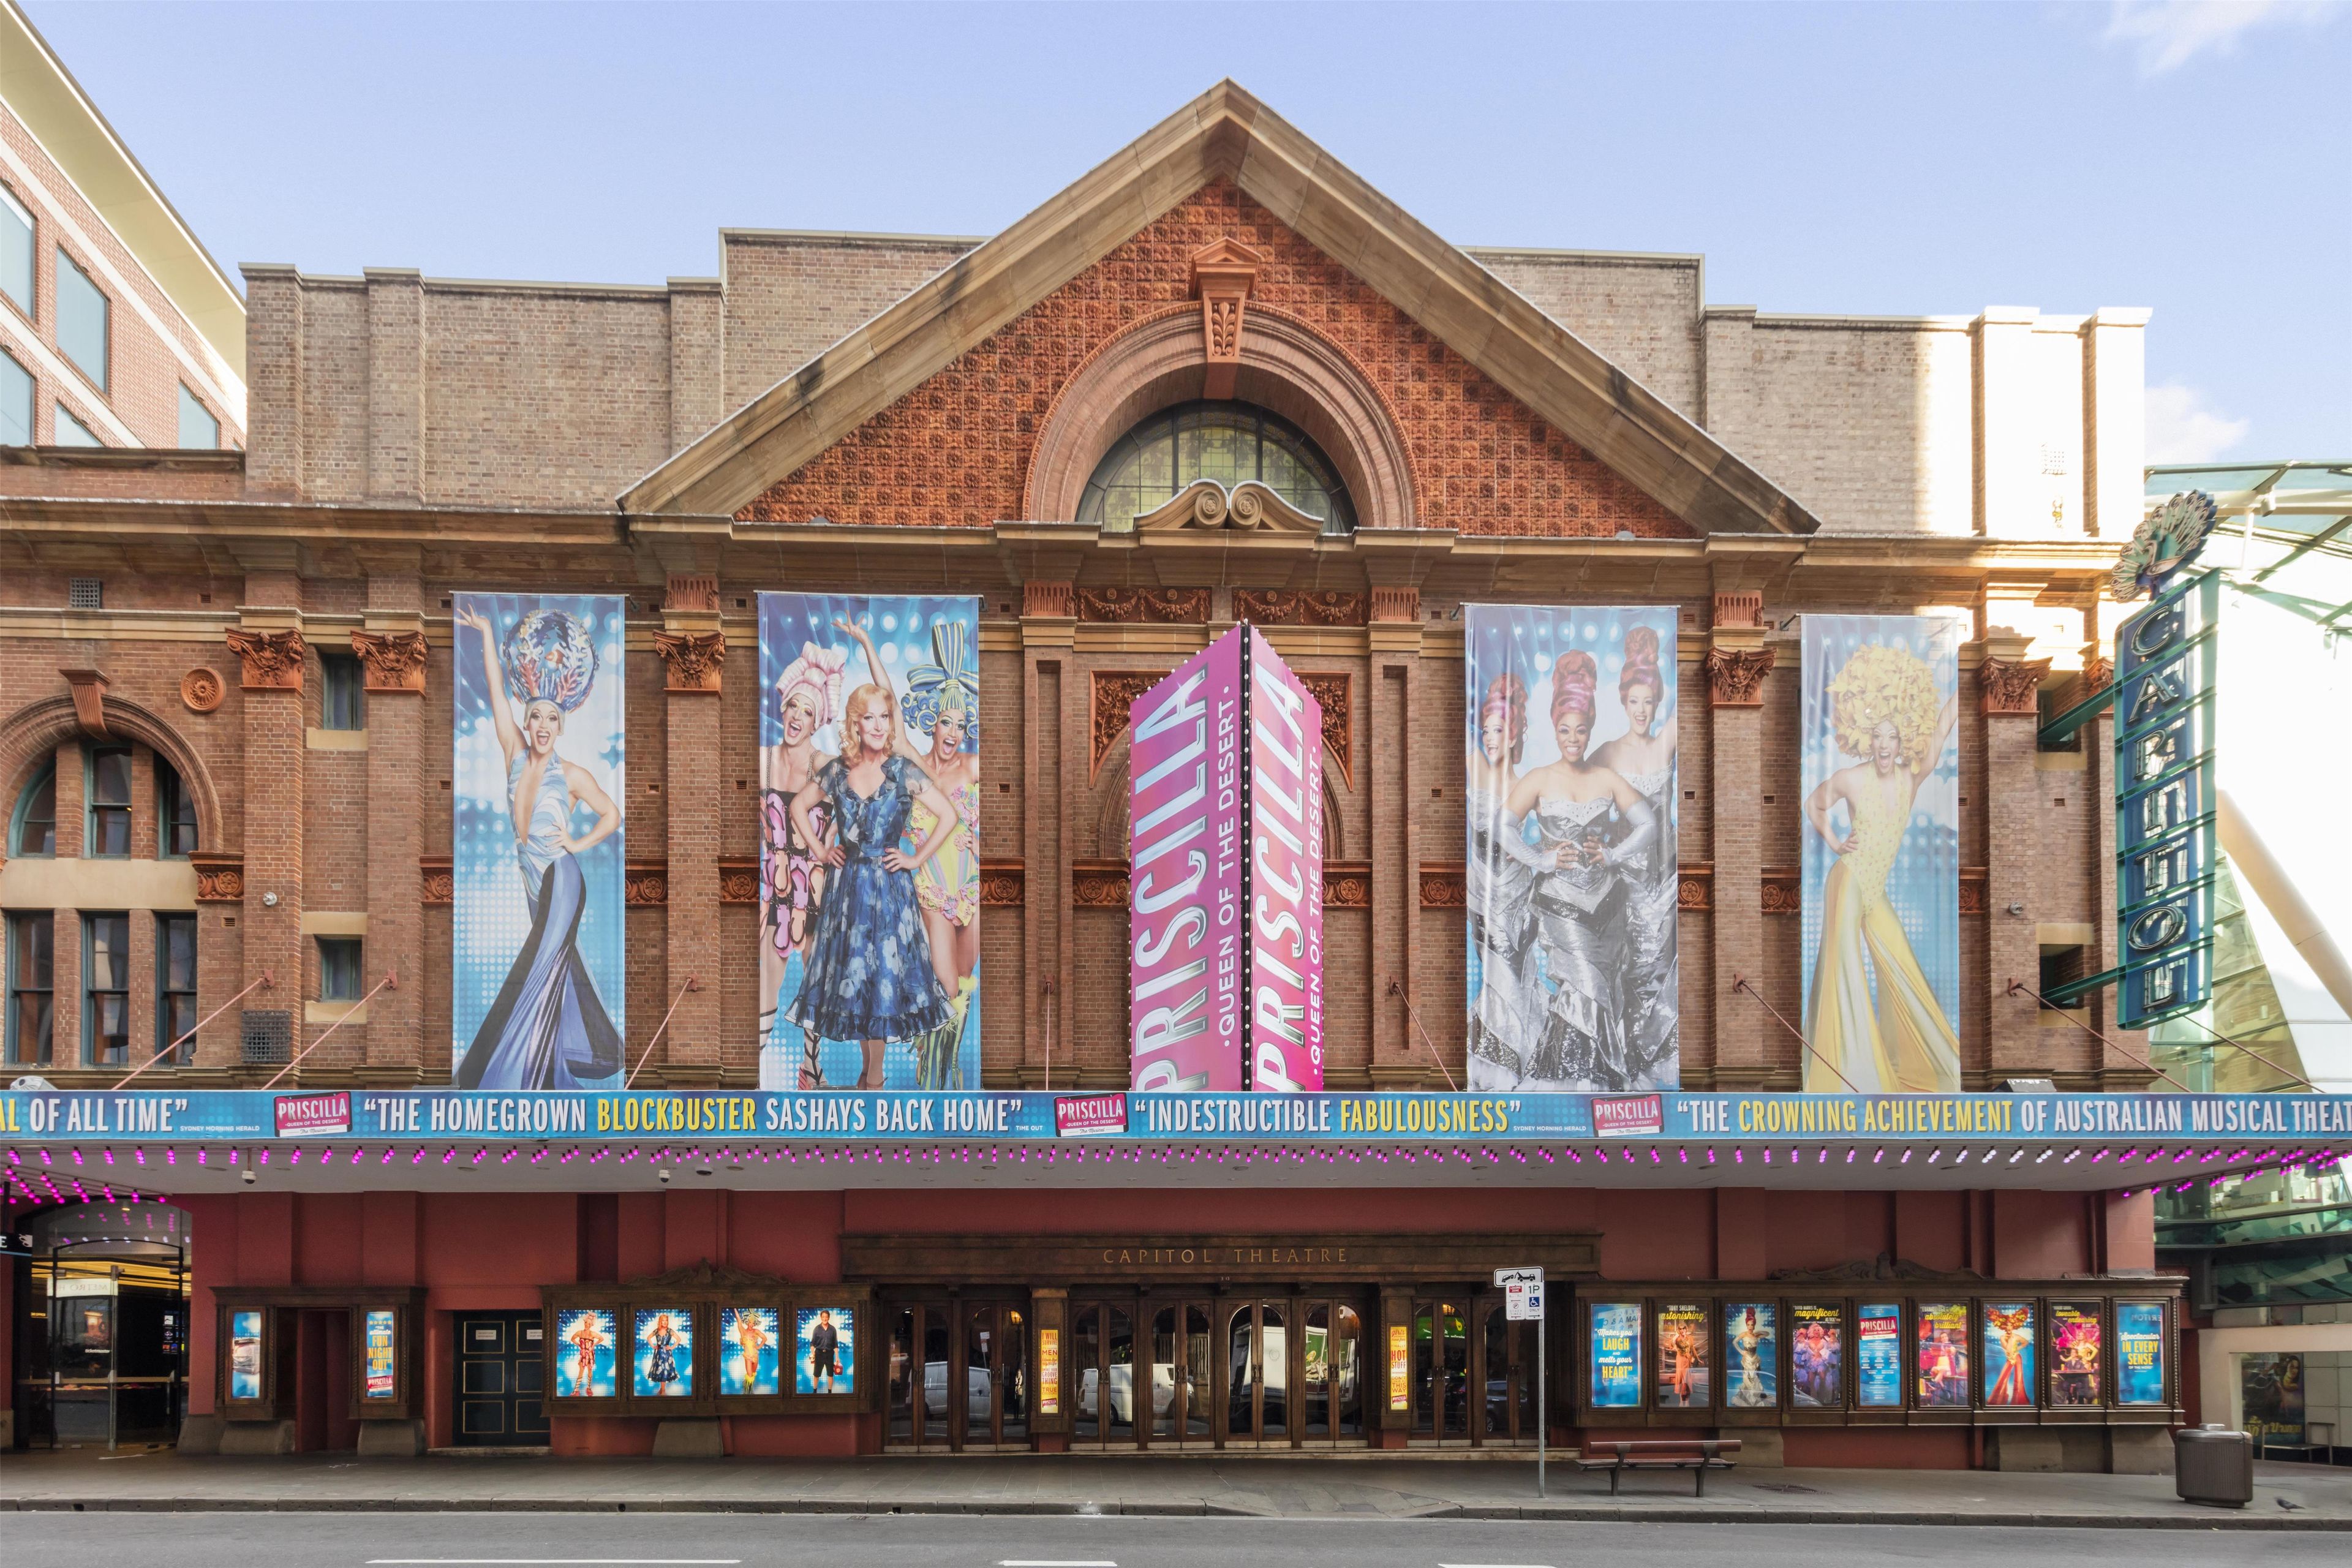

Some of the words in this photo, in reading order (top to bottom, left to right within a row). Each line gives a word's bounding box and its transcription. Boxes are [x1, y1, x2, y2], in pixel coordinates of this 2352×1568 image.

[1219, 699, 1234, 811] DESERT
[1310, 753, 1320, 860] DESERT
[2127, 605, 2183, 1009] CAPITOL
[1219, 817, 1234, 875] THE
[1135, 663, 1208, 1091] PRISCILLA
[1256, 662, 1305, 1091] PRISCILLA
[1310, 866, 1319, 916] THE
[1219, 889, 1235, 925] OF
[1310, 927, 1320, 965] OF
[1219, 935, 1235, 1035] QUEEN
[1310, 973, 1321, 1065] QUEEN
[30, 1098, 60, 1131] OF
[67, 1098, 109, 1131] ALL
[279, 1098, 347, 1120] PRISCILLA
[432, 1098, 586, 1131] HOMEGROWN
[598, 1098, 756, 1131] BLOCKBUSTER
[766, 1098, 866, 1131] SASHAYS
[876, 1098, 937, 1131] BACK
[1058, 1099, 1123, 1120] PRISCILLA
[1596, 1101, 1659, 1121] PRISCILLA
[1739, 1100, 1856, 1132] CROWNING
[1864, 1100, 2012, 1132] ACHIEVEMENT
[2022, 1100, 2047, 1131] OF
[2055, 1100, 2183, 1132] AUSTRALIAN
[2192, 1100, 2288, 1132] MUSICAL
[1103, 1250, 1212, 1264] CAPITOL
[1234, 1249, 1346, 1262] THEATRE
[1529, 1285, 1540, 1294] 1P
[1794, 1308, 1839, 1320] magnificent
[1860, 1319, 1896, 1332] PRISCILLA
[1924, 1312, 1959, 1322] absolutely
[368, 1348, 392, 1359] NIGHT
[372, 1335, 388, 1346] FUN
[1603, 1338, 1629, 1351] LAUGH
[2122, 1341, 2131, 1352] IN
[2134, 1341, 2158, 1352] EVERY
[1392, 1350, 1406, 1361] HOT
[2127, 1353, 2153, 1365] SENSE
